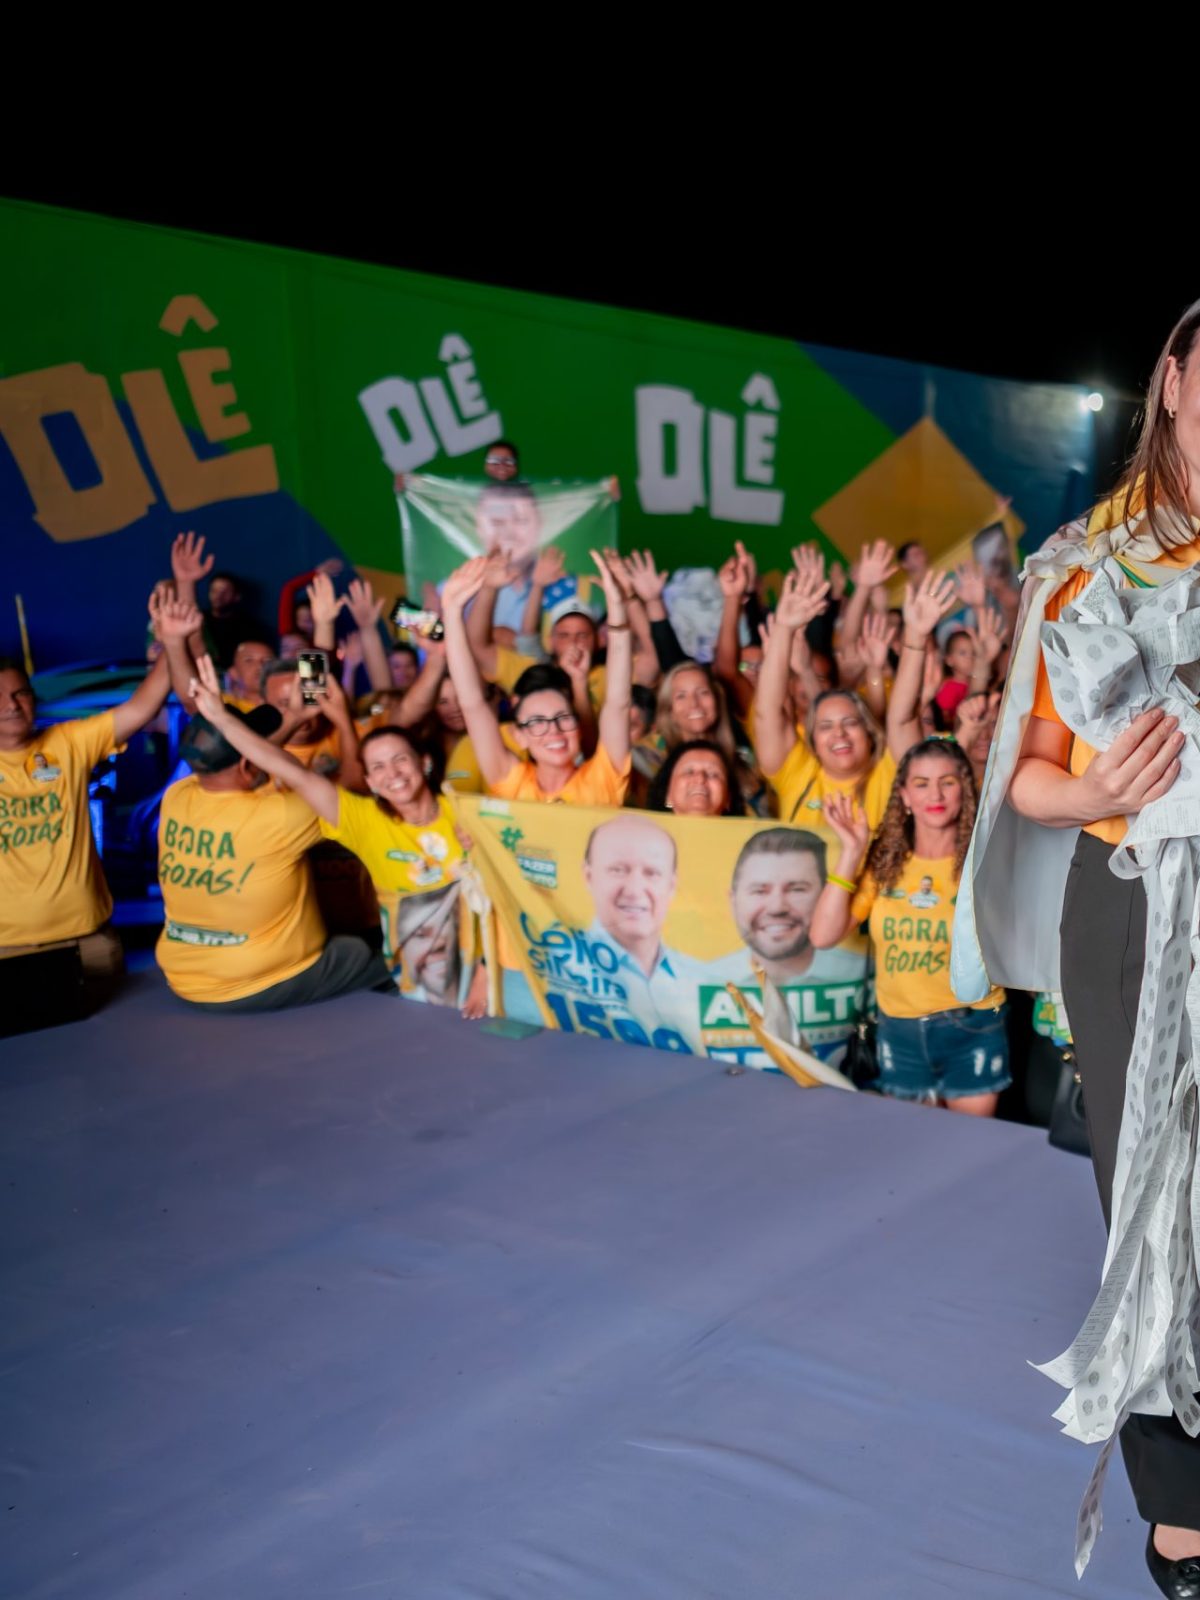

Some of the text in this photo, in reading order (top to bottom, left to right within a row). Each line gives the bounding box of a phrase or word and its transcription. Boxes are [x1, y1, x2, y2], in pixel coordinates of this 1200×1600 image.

[164, 818, 236, 860] BORA
[160, 851, 255, 895] GOIÁS!
[882, 915, 949, 944] BORA
